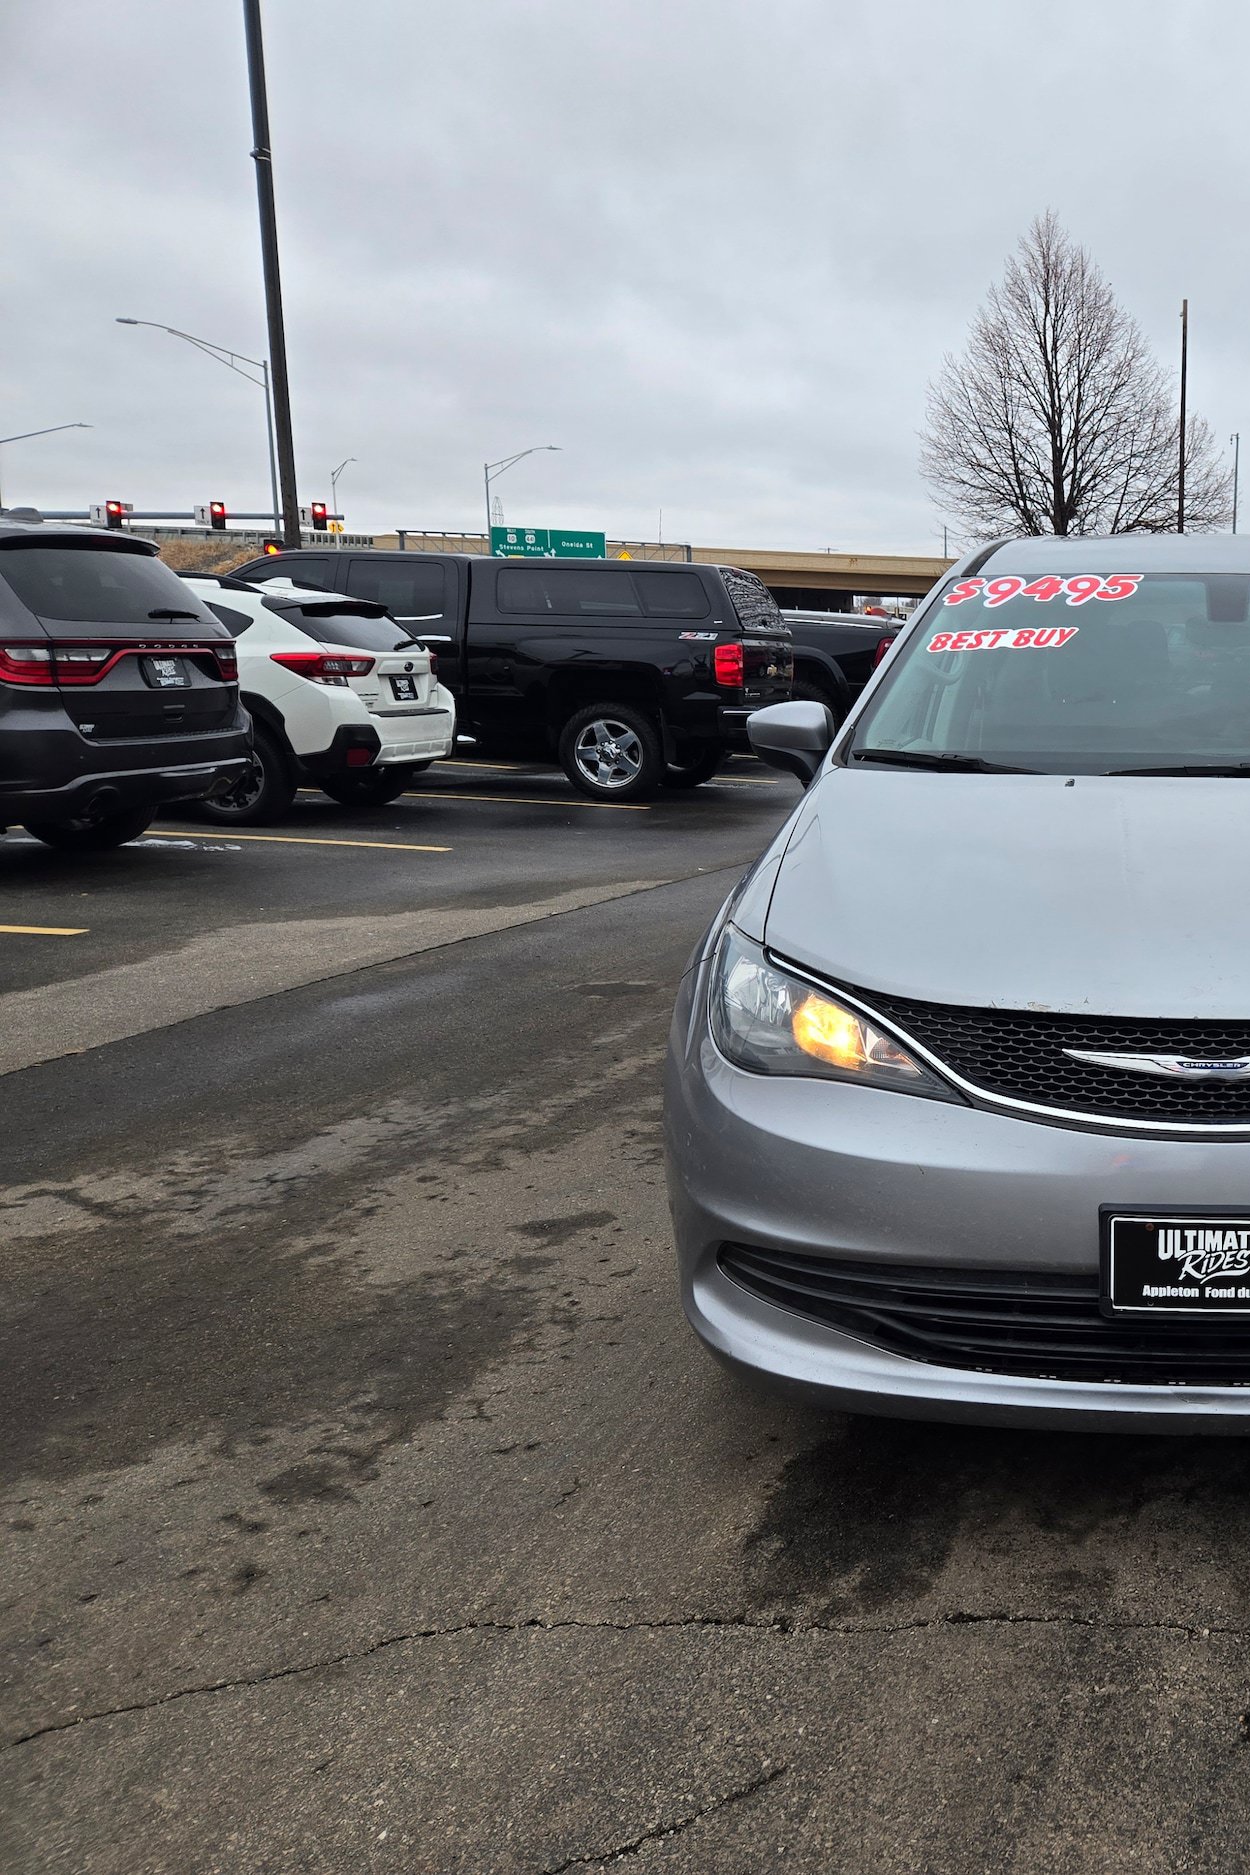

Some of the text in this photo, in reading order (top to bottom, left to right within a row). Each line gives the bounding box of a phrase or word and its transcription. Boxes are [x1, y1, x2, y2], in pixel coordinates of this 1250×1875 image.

[943, 574, 1144, 608] $9495
[927, 627, 1079, 652] BEST BUY
[1142, 1285, 1200, 1298] Appleton
[1204, 1286, 1236, 1298] Fond
